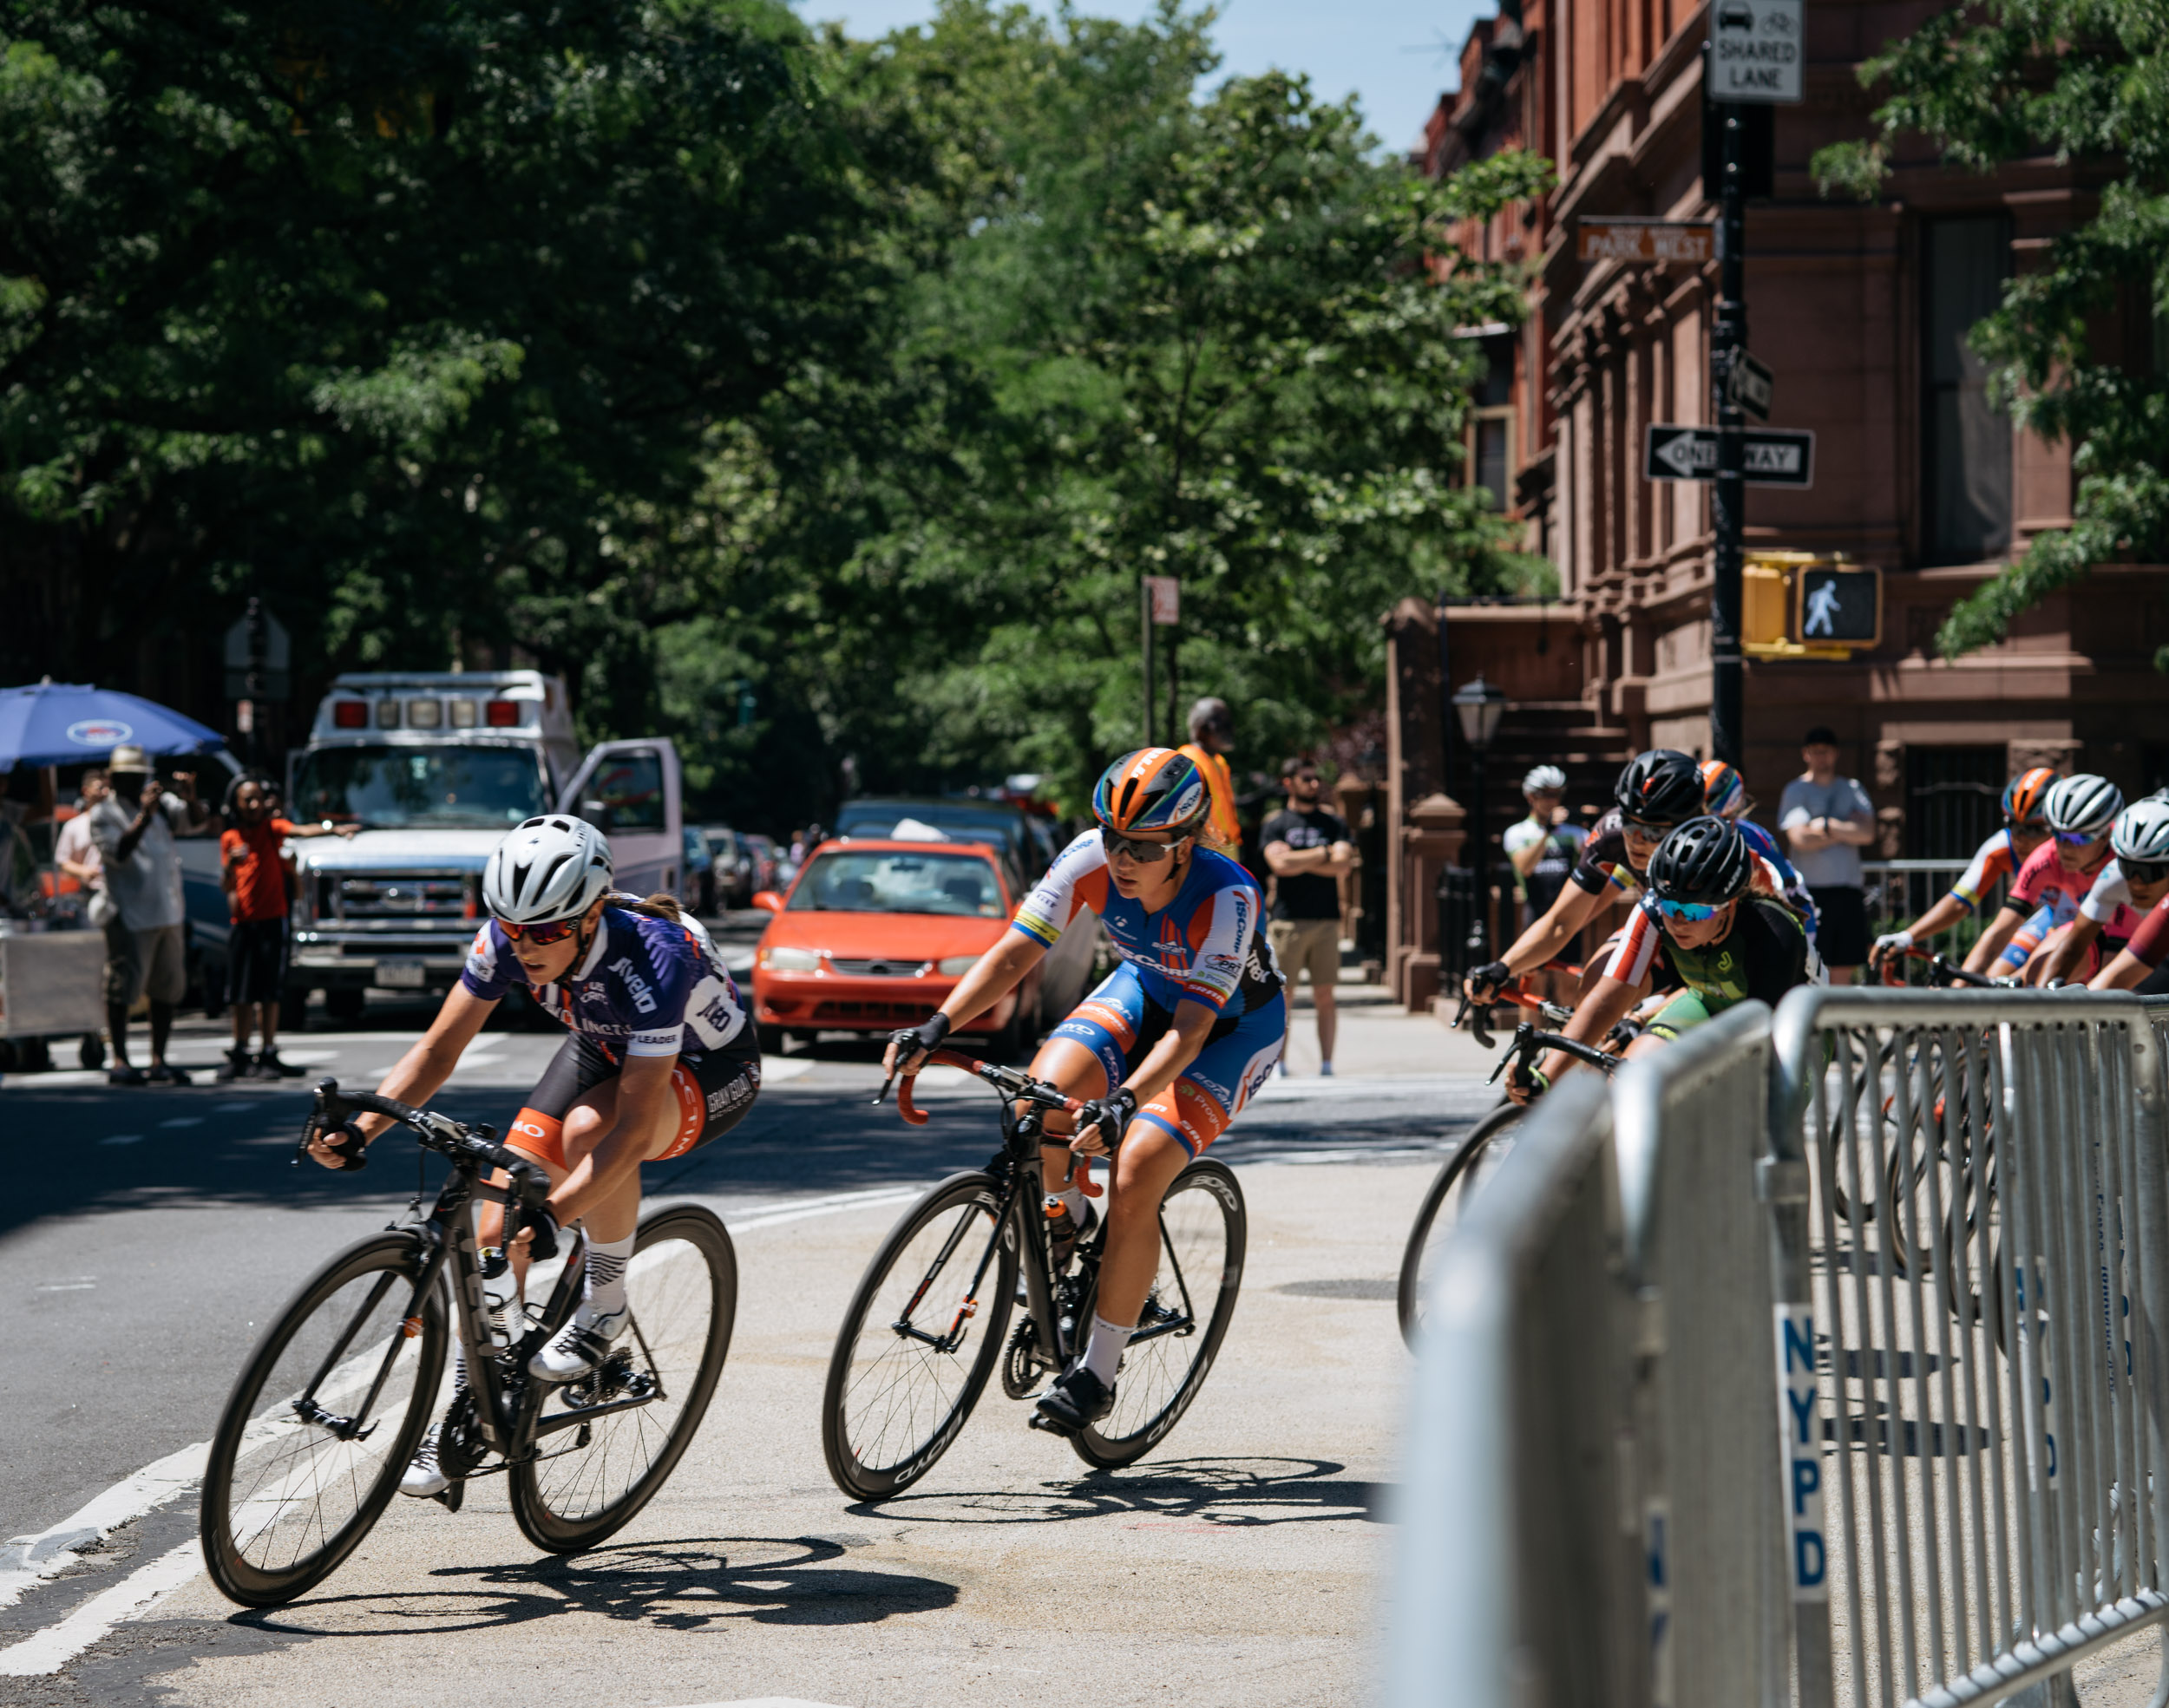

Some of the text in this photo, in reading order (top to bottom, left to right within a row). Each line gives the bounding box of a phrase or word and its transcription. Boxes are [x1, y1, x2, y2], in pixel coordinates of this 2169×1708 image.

[1719, 38, 1797, 64] SHARED
[1729, 66, 1784, 90] LANE
[1587, 234, 1708, 260] PARK WEST
[1672, 442, 1720, 467] ONE
[1784, 1318, 1826, 1587] NYPD
